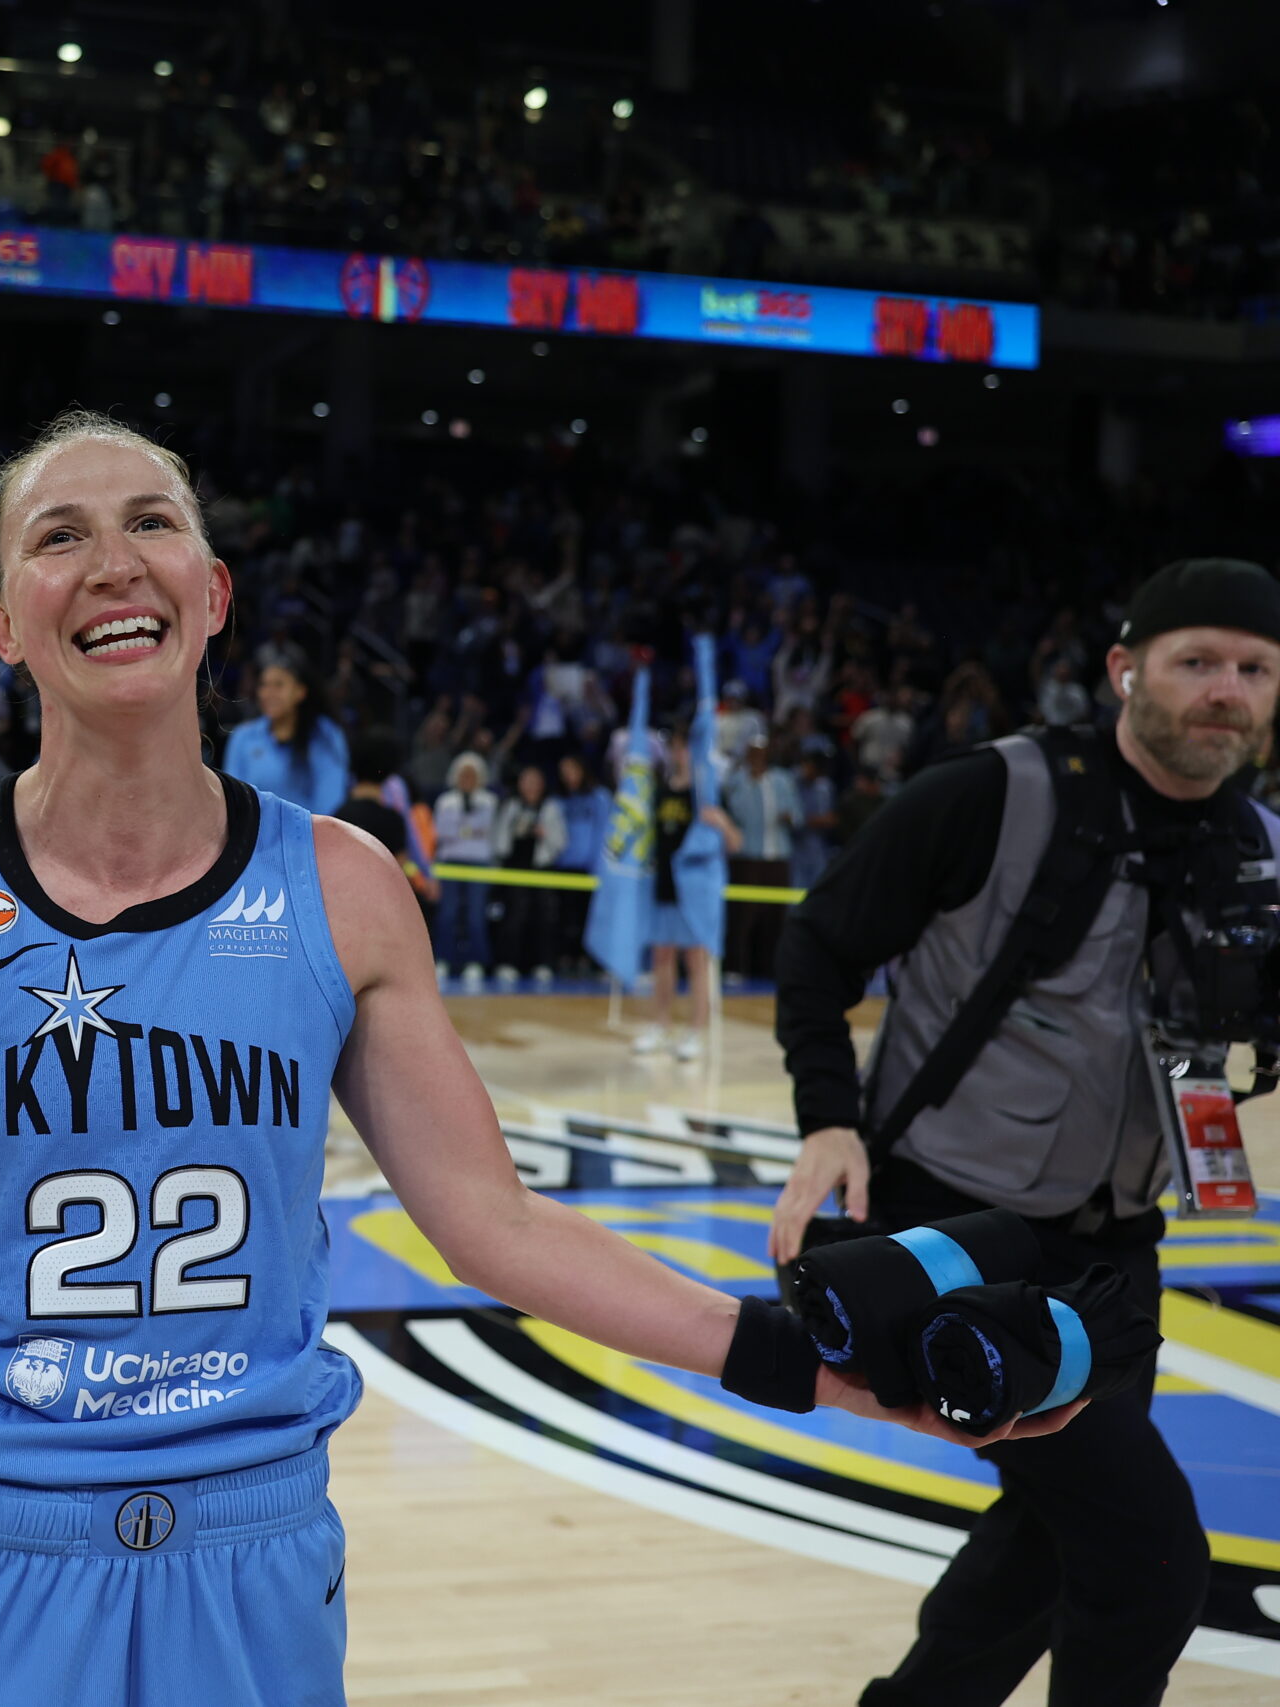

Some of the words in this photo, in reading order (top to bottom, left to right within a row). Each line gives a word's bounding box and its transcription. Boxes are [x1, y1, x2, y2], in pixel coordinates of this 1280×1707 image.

[208, 928, 288, 941] MAGELLAN
[209, 944, 288, 953] CORPORATION
[25, 1164, 251, 1320] 22
[84, 1346, 249, 1385] UChicago
